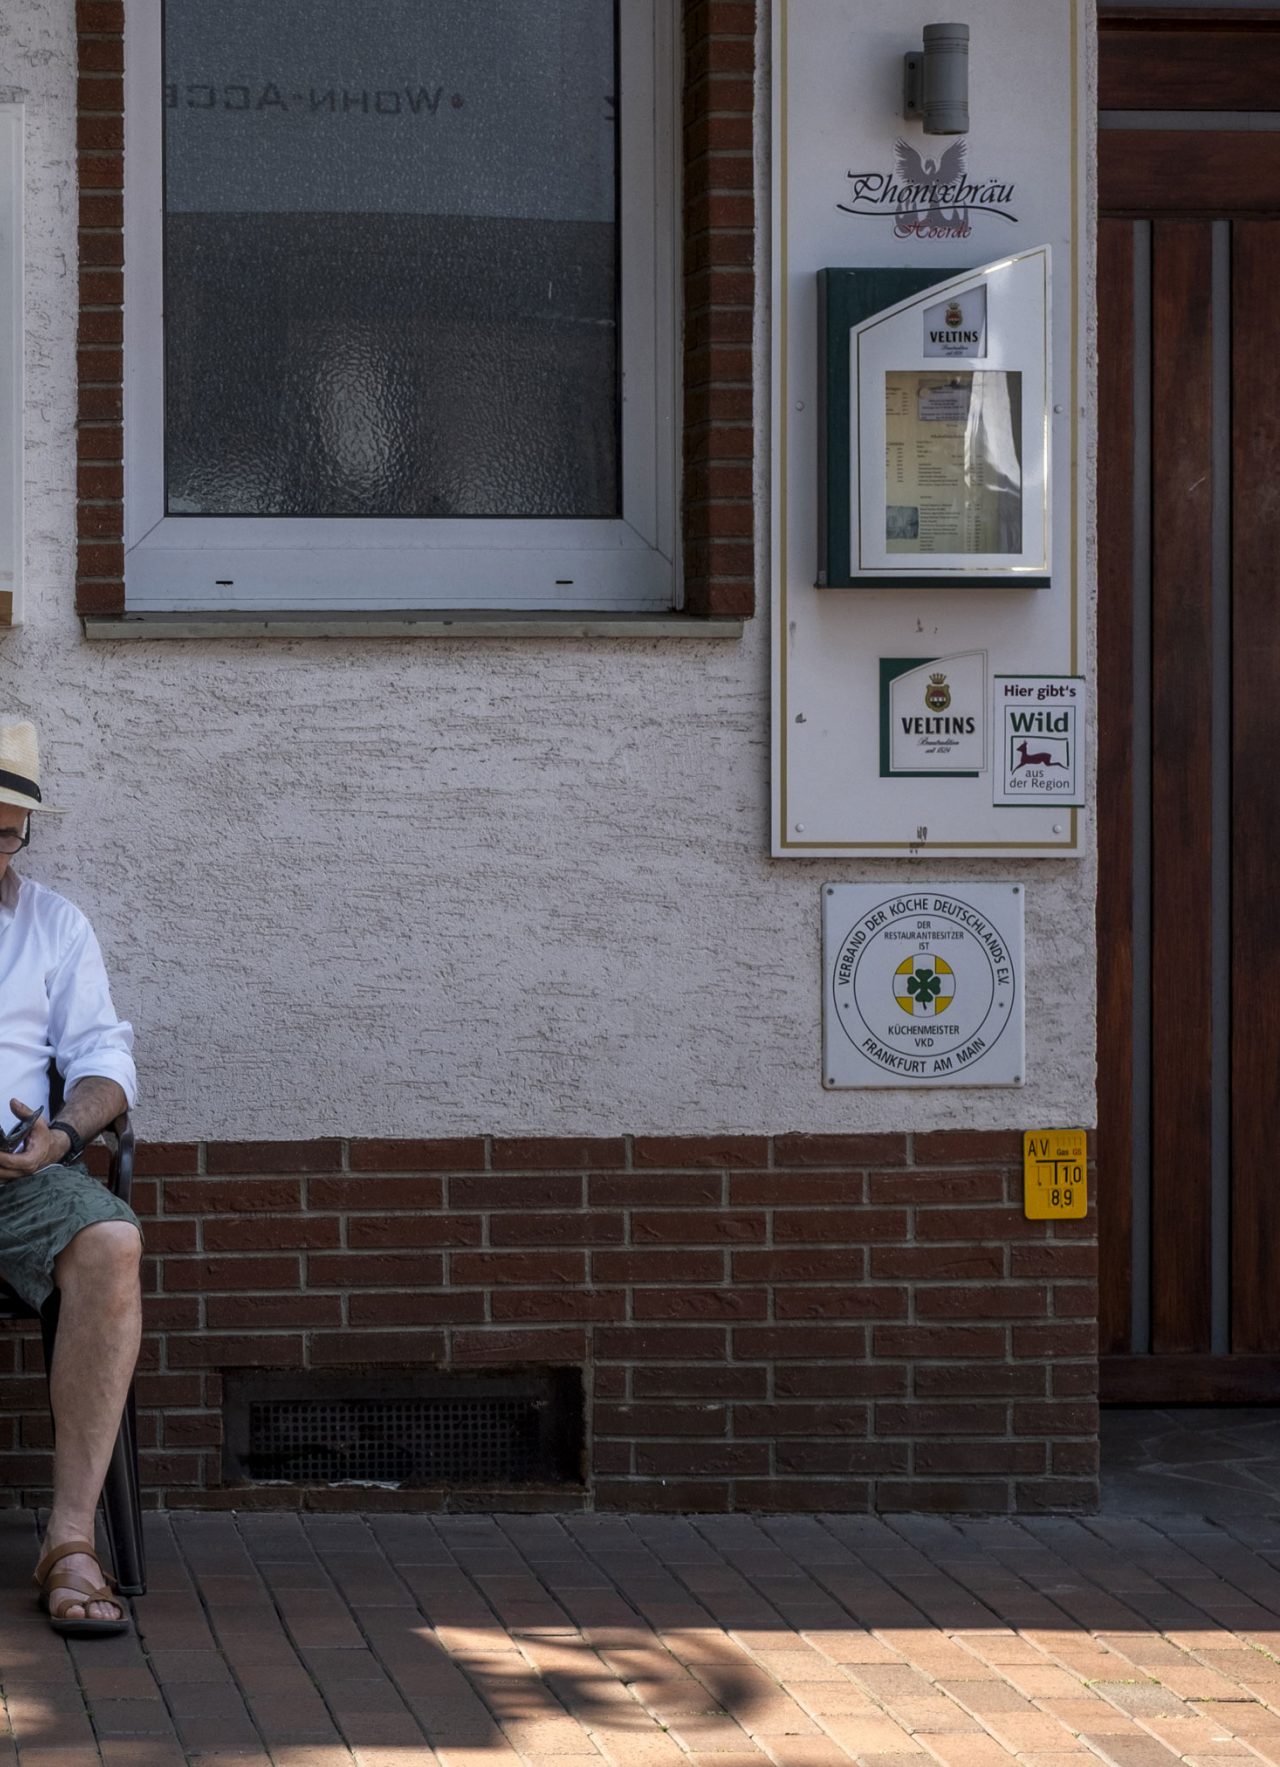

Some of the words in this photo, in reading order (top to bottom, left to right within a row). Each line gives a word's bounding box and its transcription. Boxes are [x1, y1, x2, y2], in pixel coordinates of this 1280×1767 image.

[847, 170, 1015, 204] Phönixbräu
[929, 330, 979, 343] VELTINS
[1004, 685, 1034, 697] Hier
[901, 716, 975, 734] VELTINS
[1010, 711, 1069, 732] Wild
[1025, 769, 1044, 778] aus
[1009, 778, 1028, 788] der
[1031, 778, 1070, 791] Region
[917, 921, 931, 929] DER
[839, 930, 867, 985] VERBAND
[865, 911, 888, 931] DER
[889, 898, 929, 917] KÖCHE
[933, 899, 1005, 964] DEUTSCHLANDS
[884, 931, 964, 940] RESTAURANTBESITZER
[919, 942, 929, 950] IST
[888, 1024, 960, 1035] KÜCHENMEISTER
[915, 1038, 934, 1047] VKD
[862, 1038, 927, 1073] FRANKFURT
[933, 1057, 953, 1072] AM
[956, 1037, 986, 1064] MAIN
